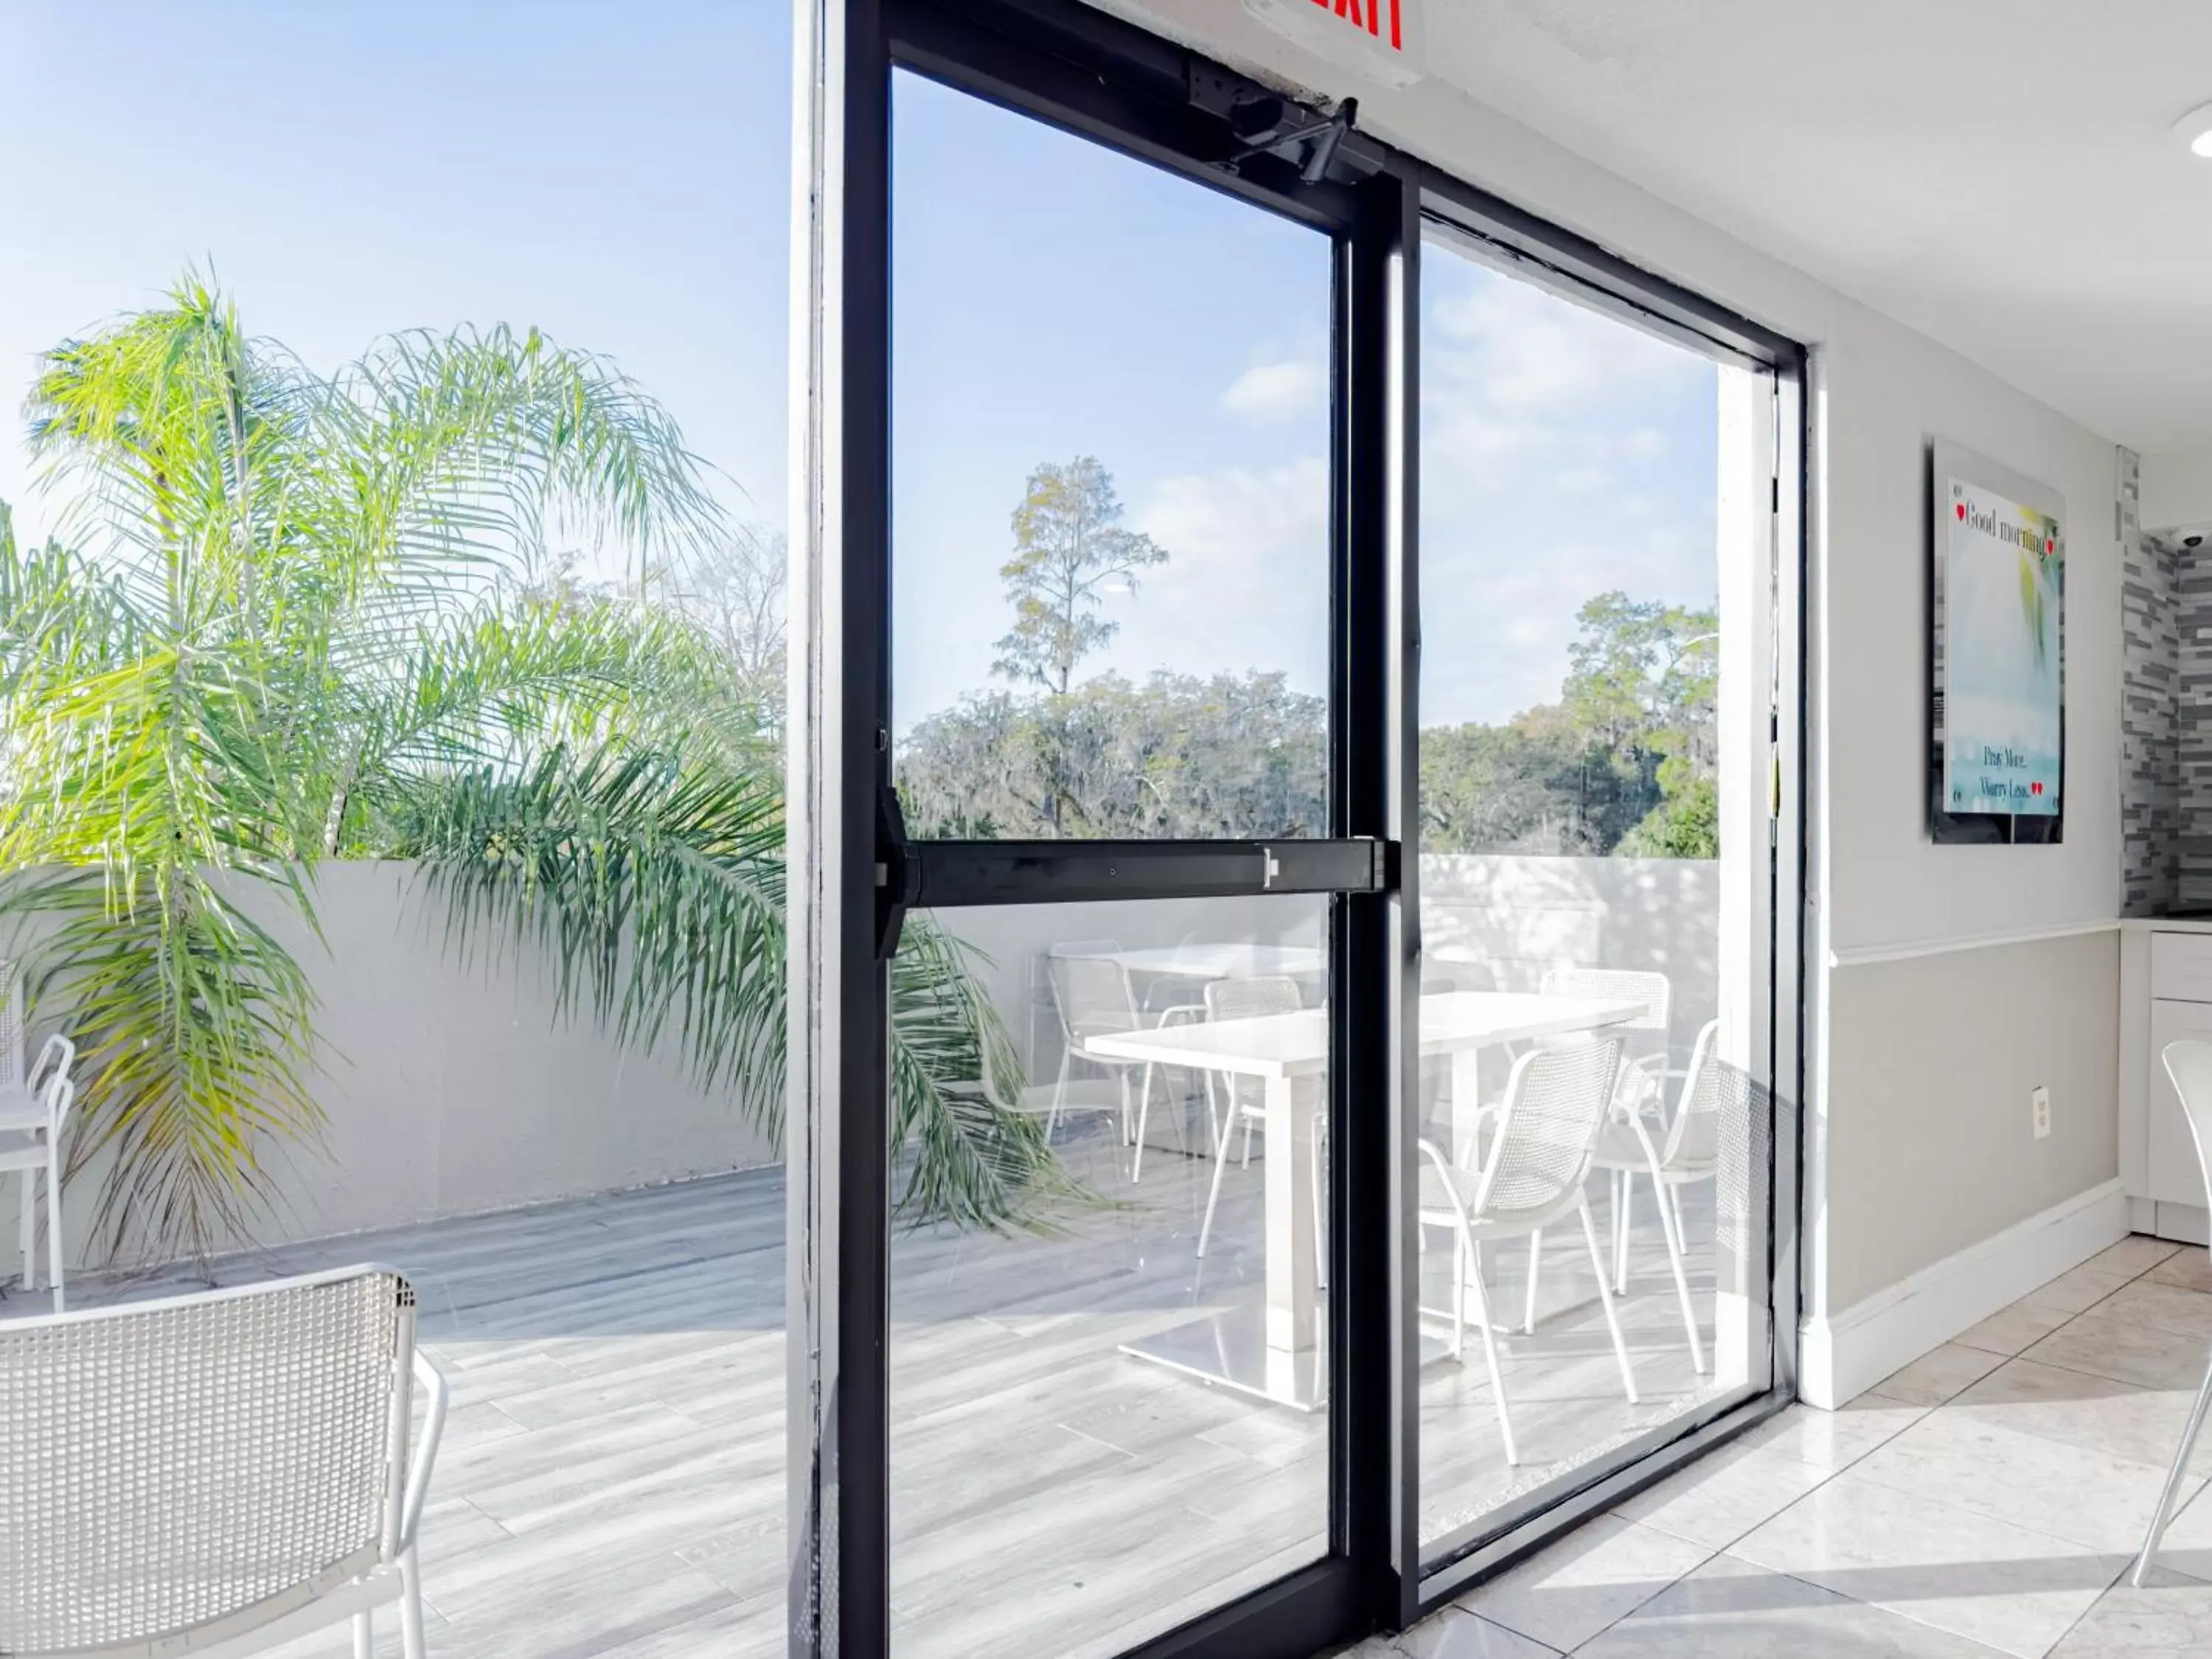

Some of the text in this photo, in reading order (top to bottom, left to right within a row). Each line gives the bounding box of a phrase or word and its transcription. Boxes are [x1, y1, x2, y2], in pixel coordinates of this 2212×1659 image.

[1966, 499, 1996, 537] Good
[1983, 745, 2003, 771] Pray
[1980, 776, 2007, 801] Worry
